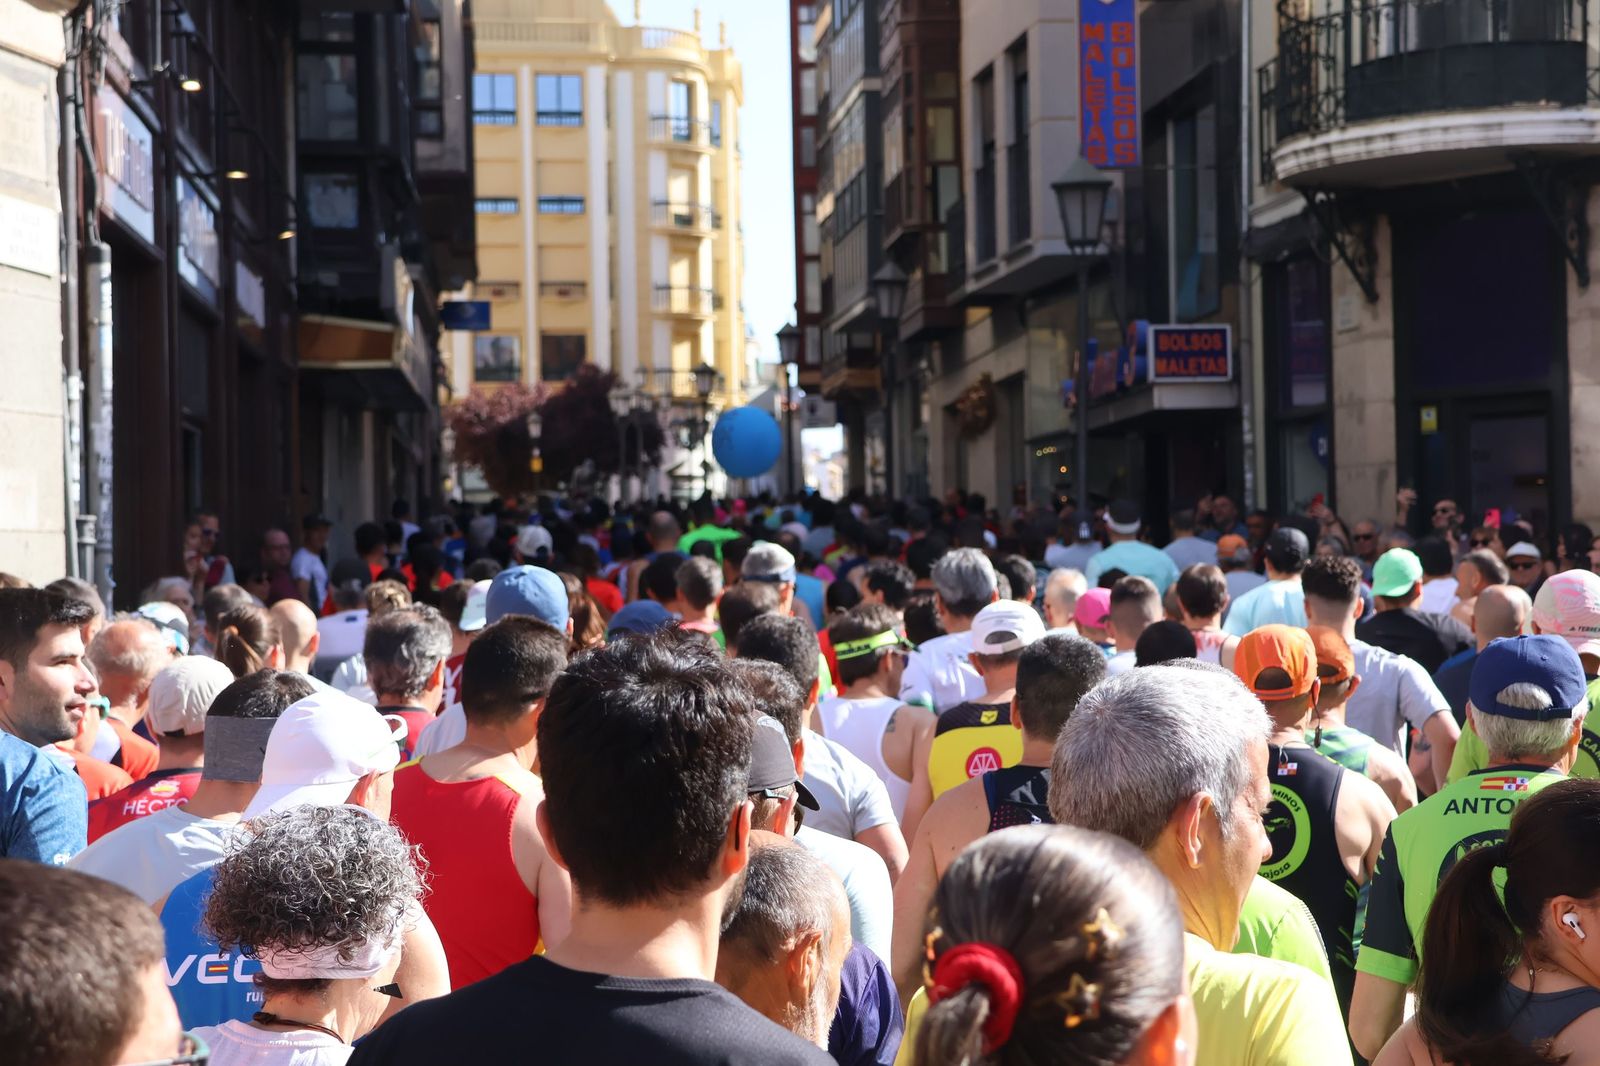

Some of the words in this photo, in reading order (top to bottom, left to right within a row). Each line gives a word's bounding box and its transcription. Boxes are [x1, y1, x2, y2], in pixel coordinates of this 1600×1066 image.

[1084, 23, 1107, 164] MALETAS
[1111, 22, 1136, 164] BOLSOS
[1158, 333, 1222, 350] BOLSOS
[1156, 356, 1227, 375] MALETAS
[1443, 798, 1522, 816] ANTO
[1259, 862, 1291, 879] ajosa
